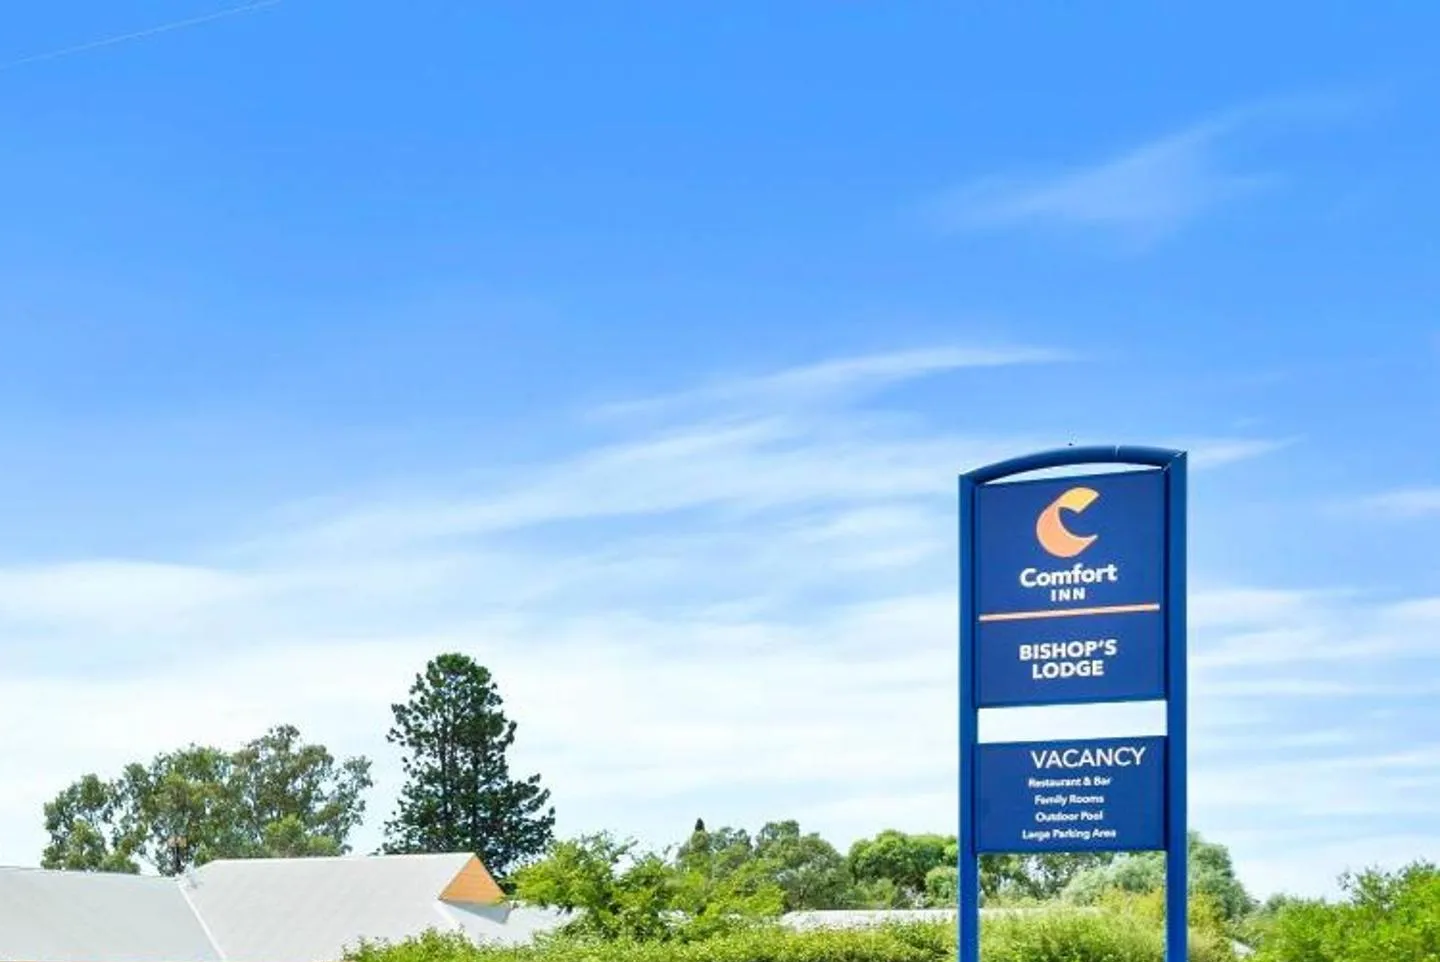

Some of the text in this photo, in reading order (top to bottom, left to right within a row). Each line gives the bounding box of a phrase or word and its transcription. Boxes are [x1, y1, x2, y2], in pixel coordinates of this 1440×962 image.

[1020, 563, 1118, 588] Comfort
[1051, 588, 1086, 602] INN
[1019, 639, 1118, 661] BISHOP'S
[1032, 660, 1104, 680] LODGE
[1031, 746, 1147, 769] VACANCY
[1028, 776, 1112, 788] Restaurant & Bar
[1034, 794, 1105, 807] Family Rooms
[1035, 810, 1104, 823] Outdoor Pool
[1022, 828, 1117, 842] Large Parking Area
